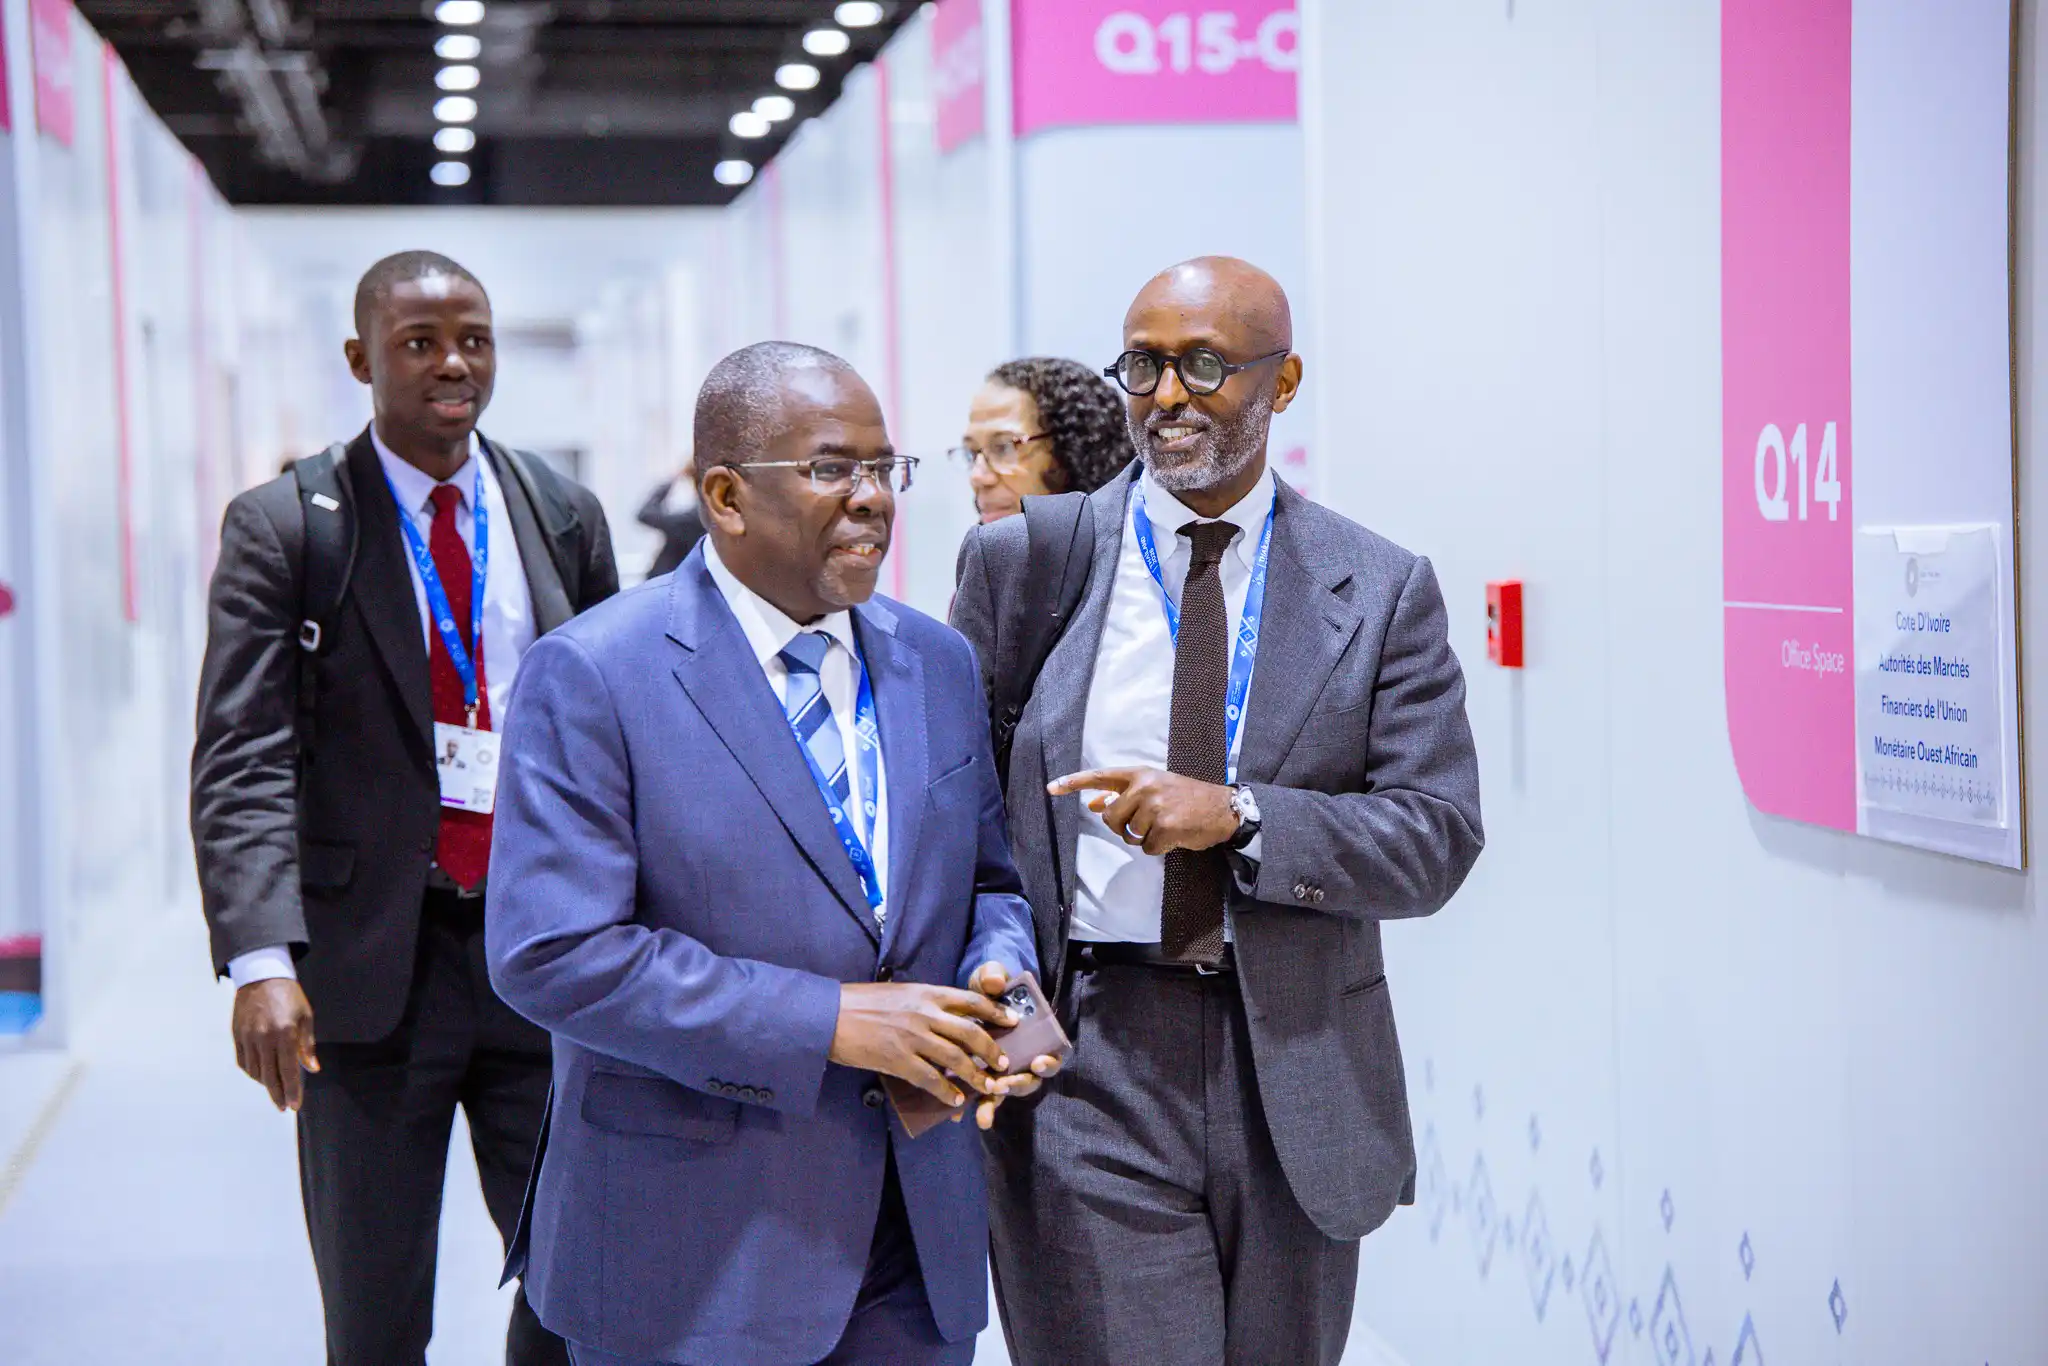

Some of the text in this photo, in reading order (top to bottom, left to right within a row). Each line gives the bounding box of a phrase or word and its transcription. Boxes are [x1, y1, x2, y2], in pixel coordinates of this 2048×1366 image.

[1755, 421, 1841, 521] Q14
[1140, 536, 1154, 569] THAILAND
[1896, 611, 1951, 633] Cote D'Ivoire
[1781, 639, 1844, 678] Office Space
[1878, 653, 1970, 678] Autorités des Marchés
[1881, 694, 1968, 723] Financiers de l'Union
[1874, 735, 1978, 769] Monétaire Ouest Africain
